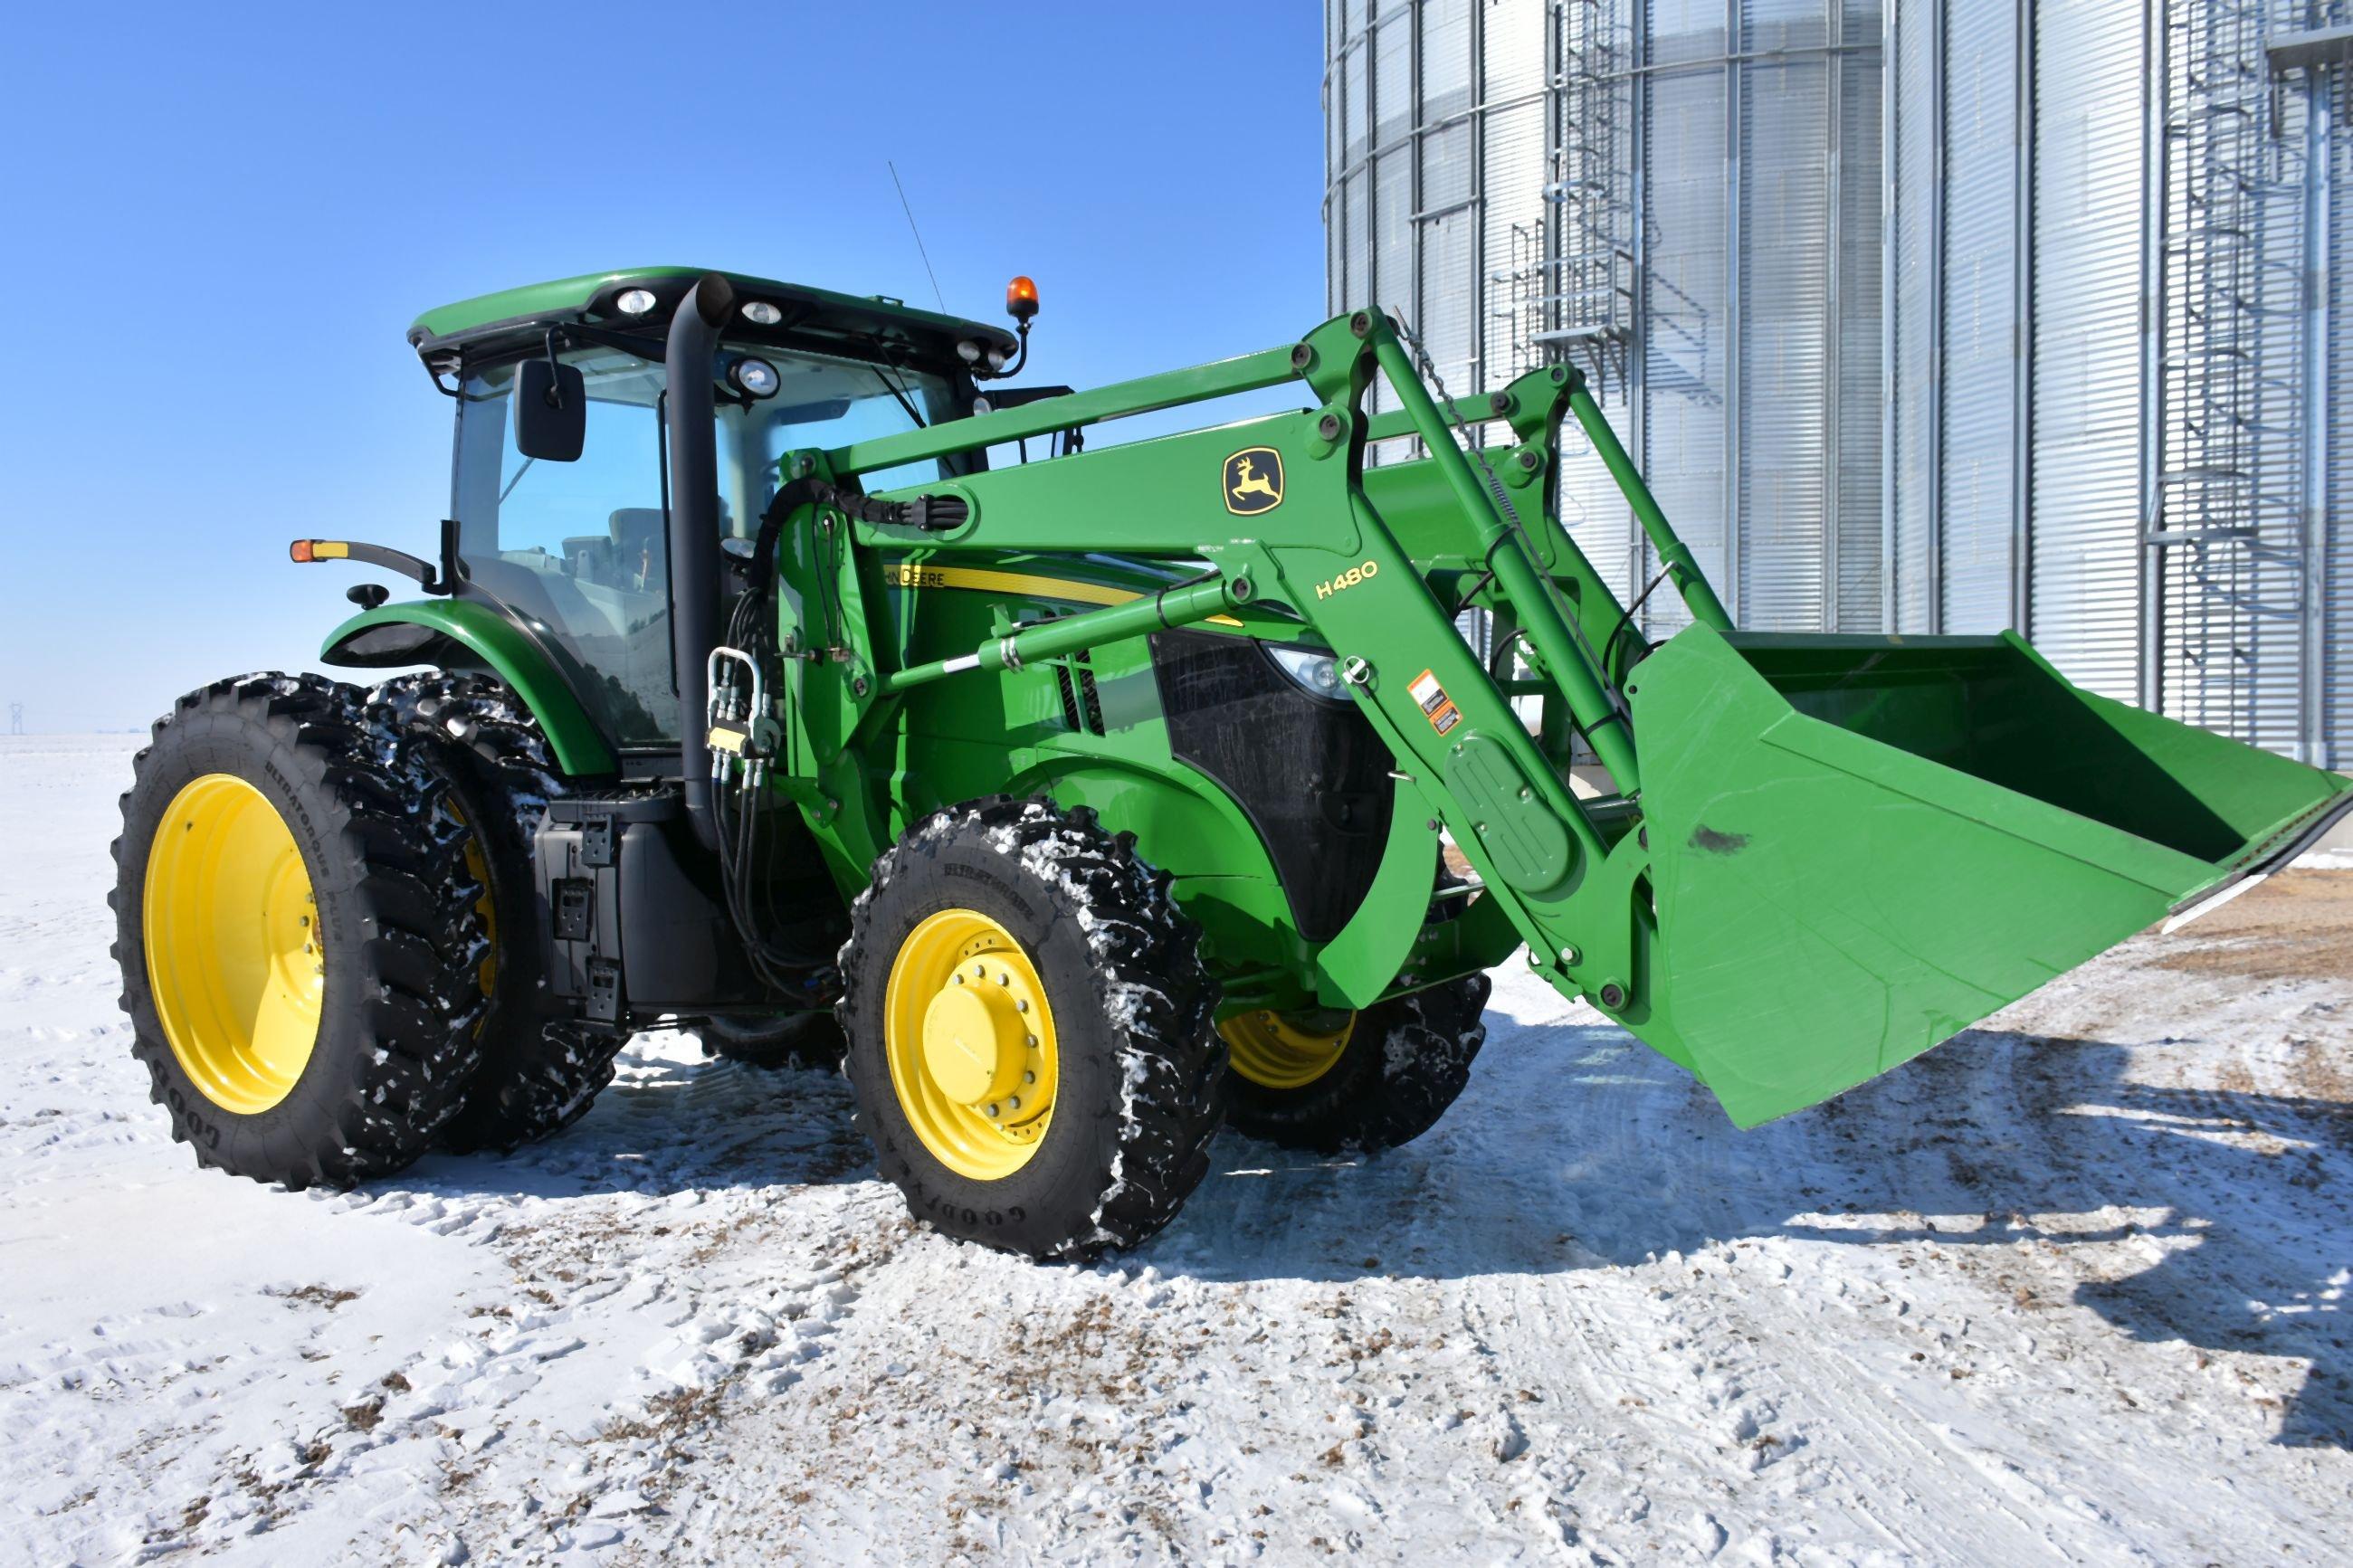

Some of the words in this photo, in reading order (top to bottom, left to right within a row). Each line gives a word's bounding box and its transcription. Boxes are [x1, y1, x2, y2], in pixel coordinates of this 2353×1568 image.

[902, 568, 945, 586] DEERE
[1315, 560, 1377, 600] H480
[265, 761, 330, 878] ULTRATORQUE
